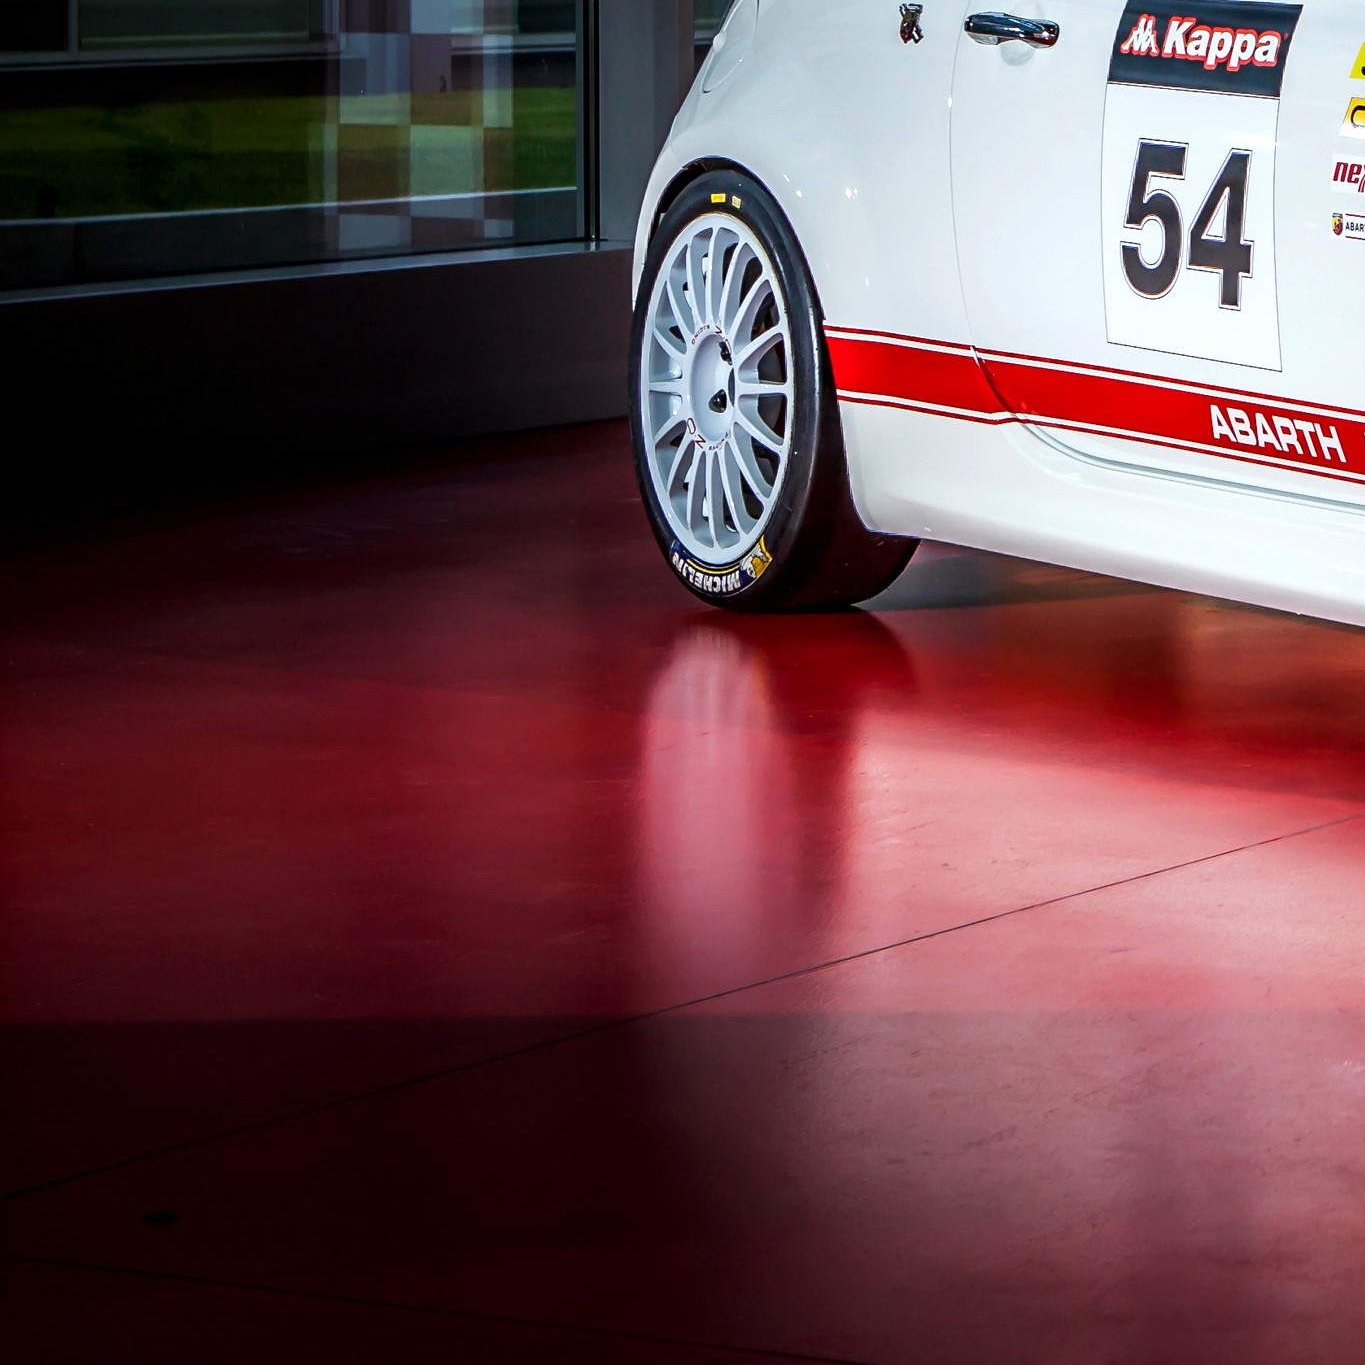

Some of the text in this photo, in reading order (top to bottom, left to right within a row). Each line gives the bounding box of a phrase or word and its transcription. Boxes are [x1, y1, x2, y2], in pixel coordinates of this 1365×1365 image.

[1162, 16, 1281, 71] Kappa
[1119, 137, 1254, 311] 54
[1209, 404, 1347, 463] ABARTH
